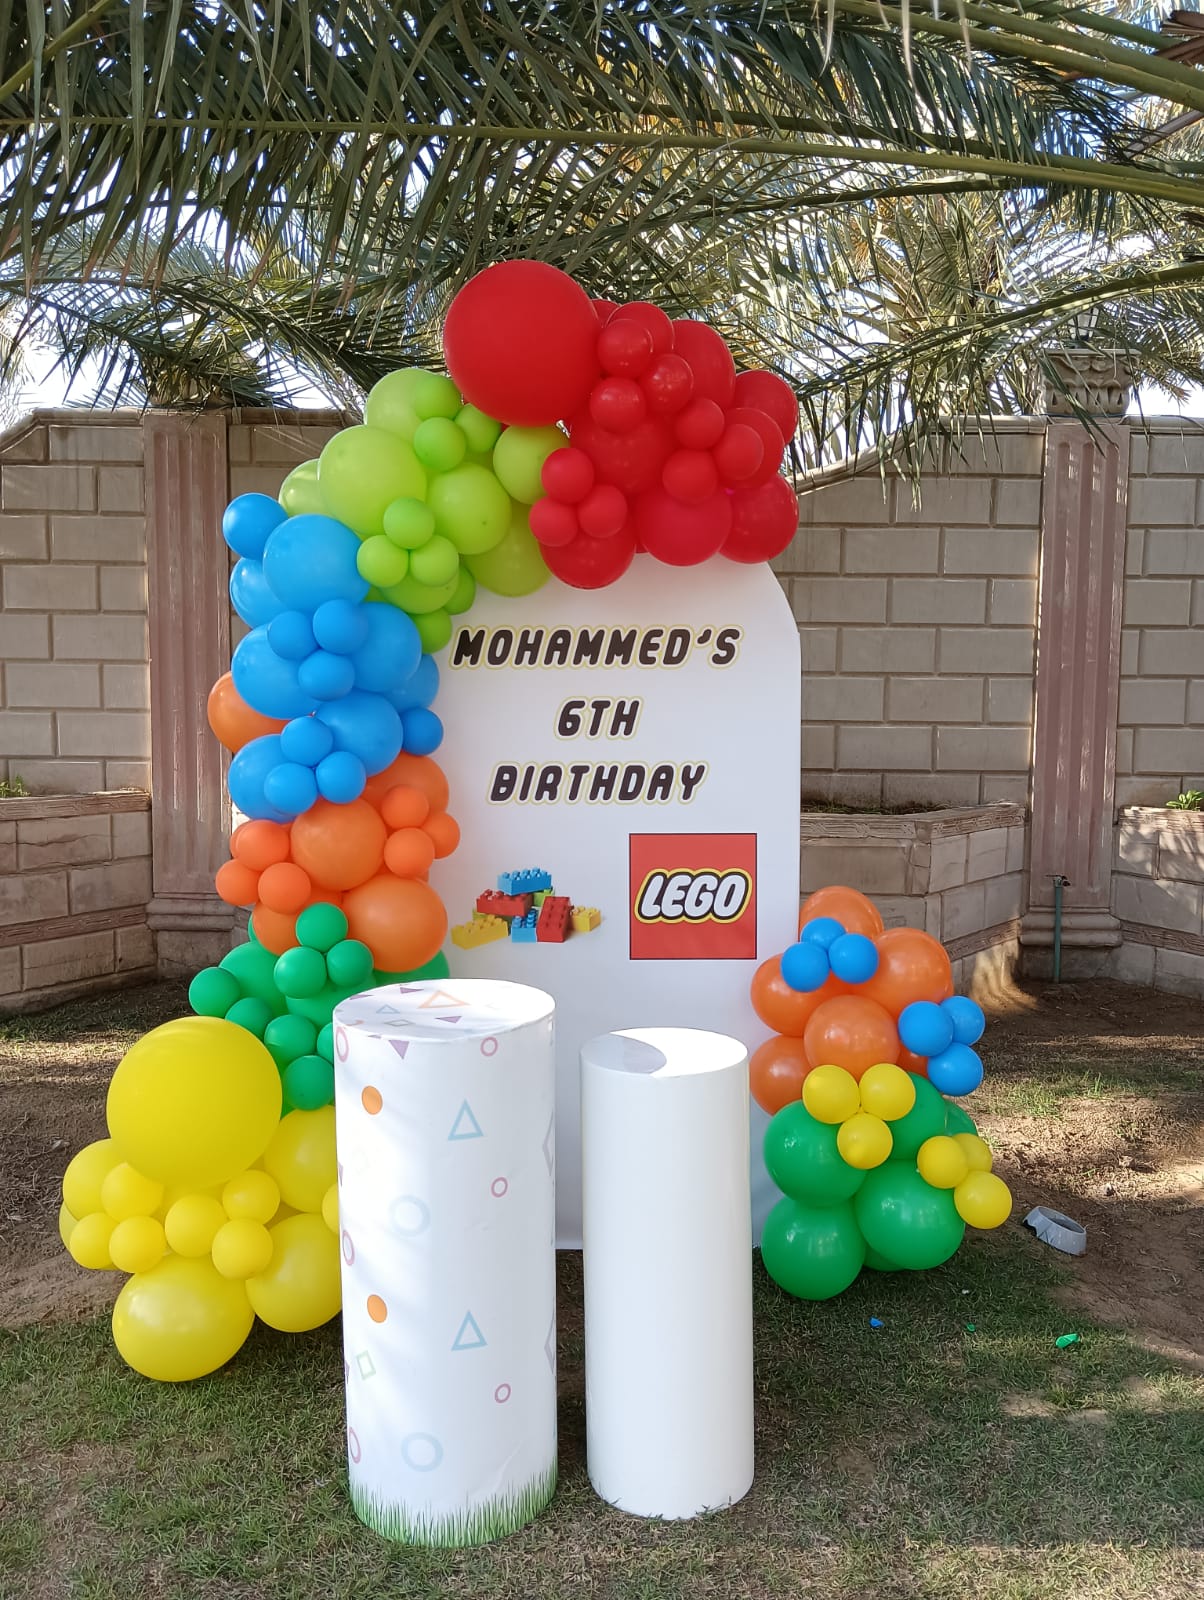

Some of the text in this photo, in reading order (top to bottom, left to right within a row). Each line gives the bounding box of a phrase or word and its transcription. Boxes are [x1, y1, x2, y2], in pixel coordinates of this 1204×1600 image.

[452, 627, 741, 667] MOHAMMED'S
[557, 699, 640, 737] 6TH
[489, 764, 706, 802] BIRTHDAY
[636, 873, 748, 919] LEGO
